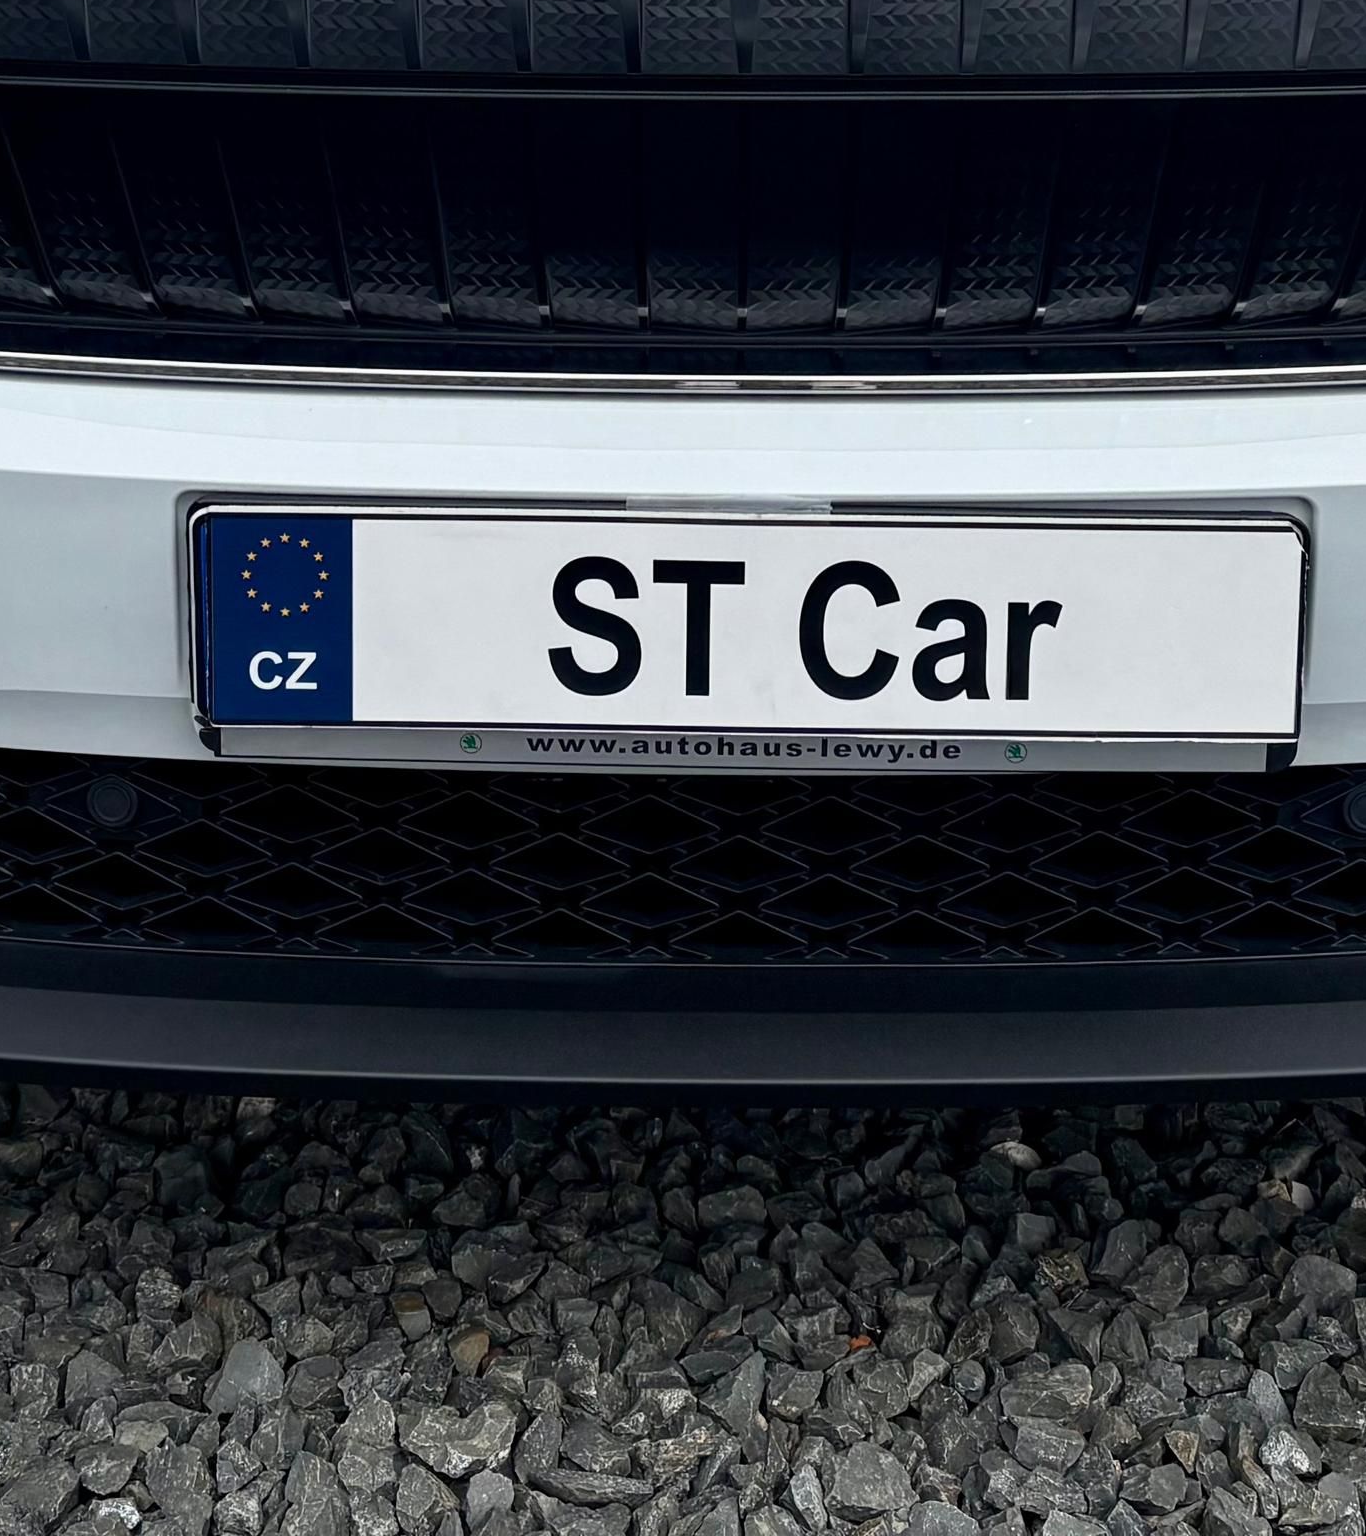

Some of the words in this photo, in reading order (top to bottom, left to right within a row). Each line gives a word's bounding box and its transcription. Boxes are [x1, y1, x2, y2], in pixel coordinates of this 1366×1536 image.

[547, 555, 746, 698] ST
[798, 560, 1063, 702] Car
[248, 650, 319, 691] CZ
[526, 735, 962, 764] www.autohaus-lewy.de
